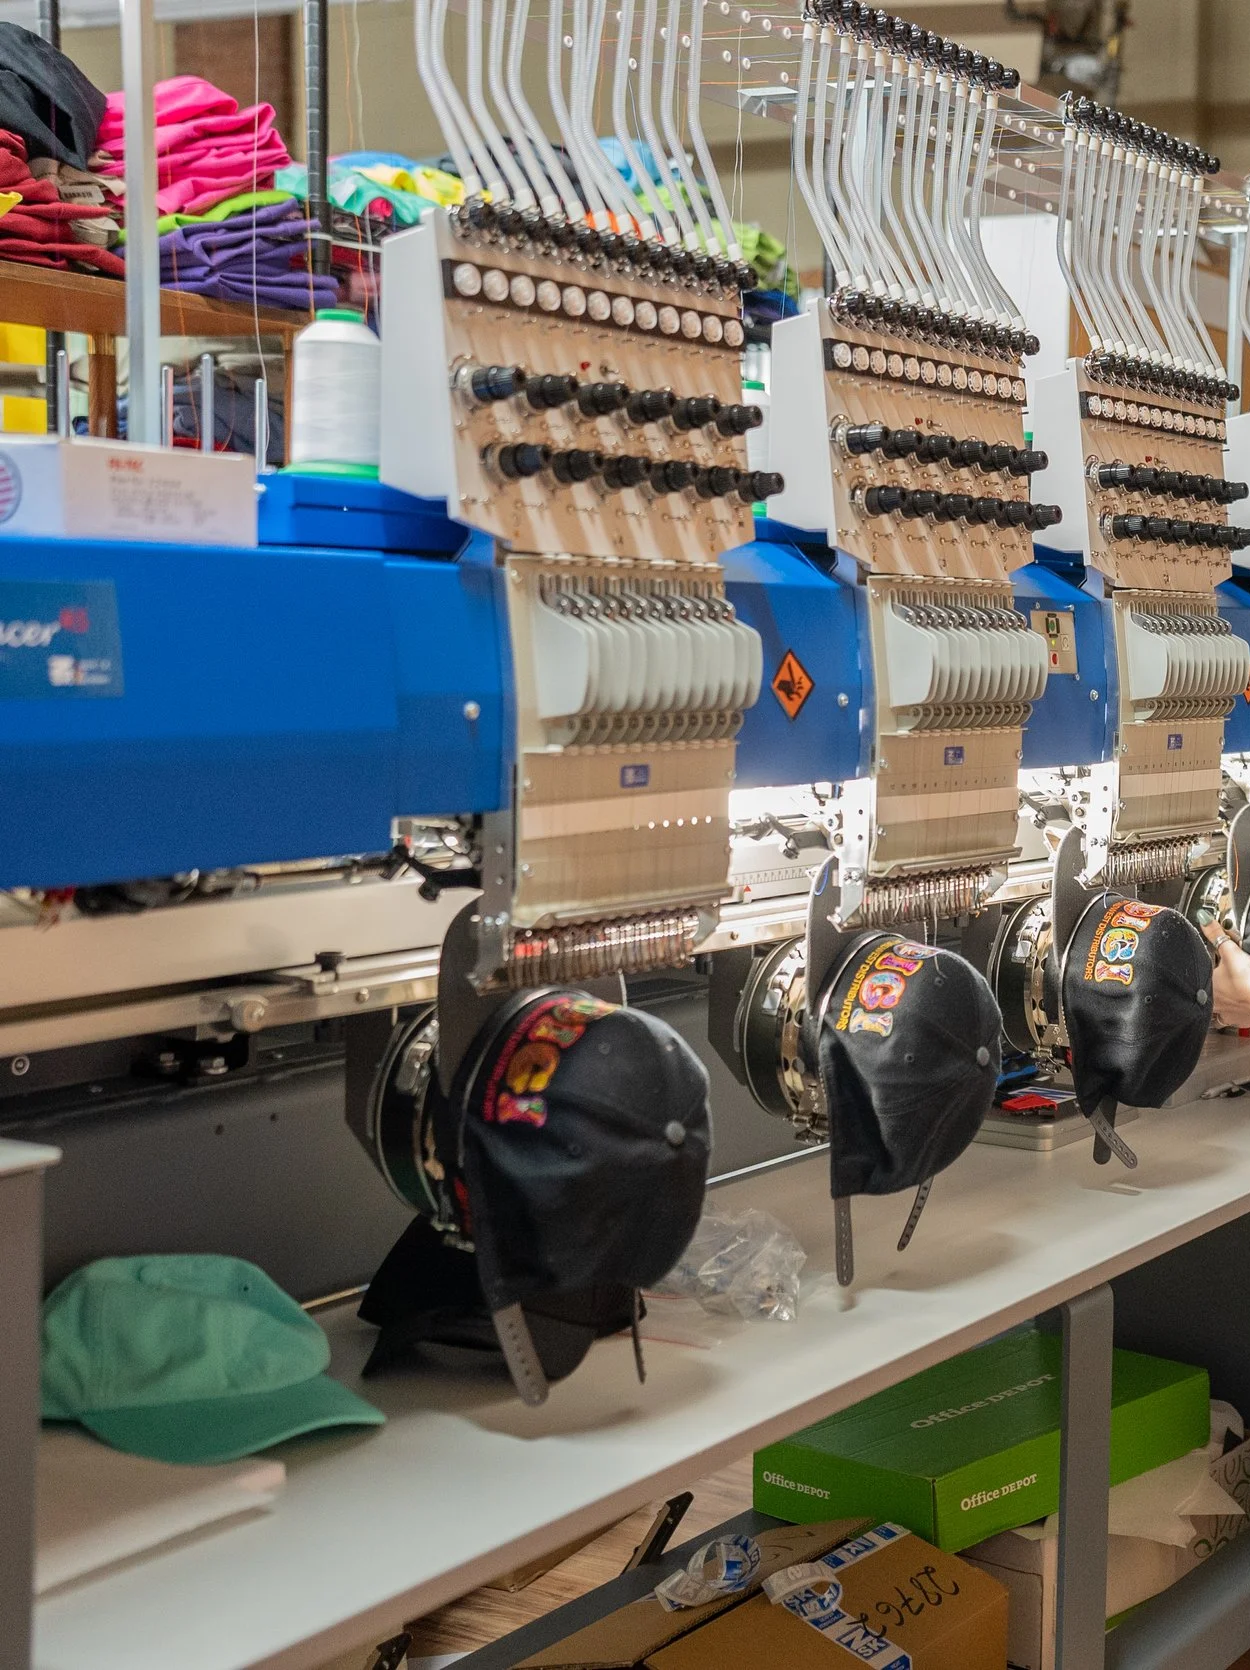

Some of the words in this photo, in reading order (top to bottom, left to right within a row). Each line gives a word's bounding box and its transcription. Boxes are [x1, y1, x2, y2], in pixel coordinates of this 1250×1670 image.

[1084, 922, 1107, 981] DISTRIBUTORS
[835, 964, 869, 1031] DISTRIBUTORS
[910, 1398, 989, 1429] Office
[988, 1373, 1056, 1403] DEPOT
[763, 1471, 797, 1492] Office
[797, 1483, 830, 1500] DEPOT
[960, 1488, 1001, 1511] Office
[1001, 1474, 1038, 1496] DEPOT
